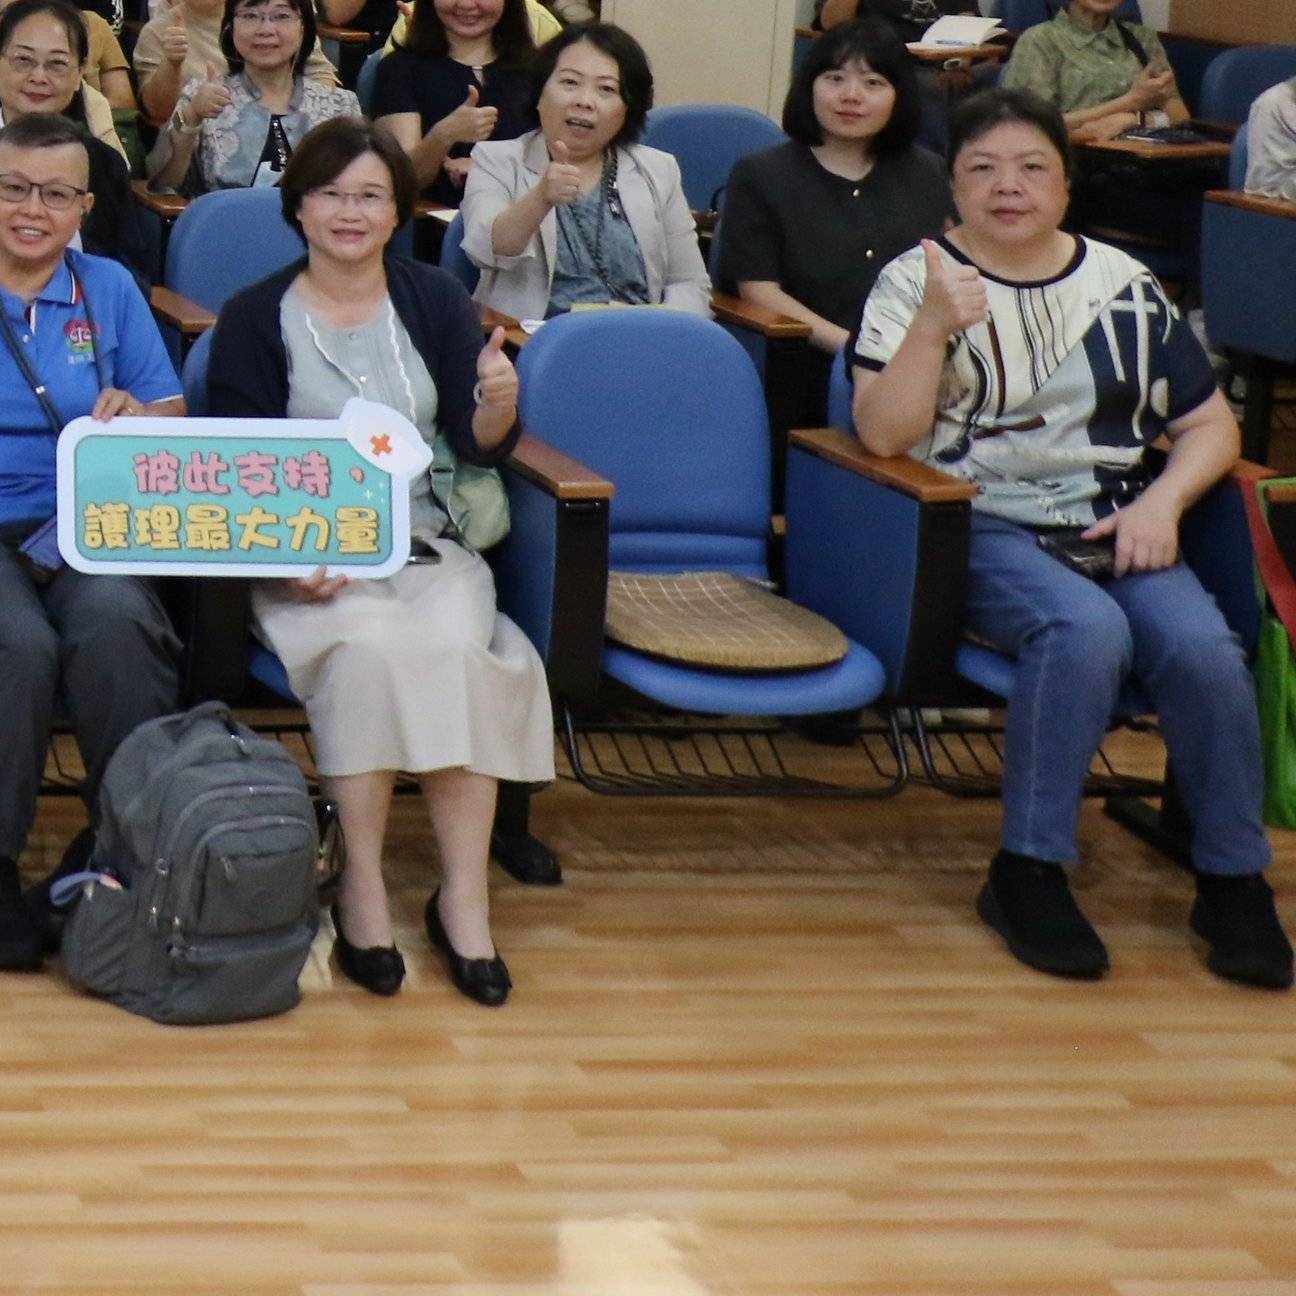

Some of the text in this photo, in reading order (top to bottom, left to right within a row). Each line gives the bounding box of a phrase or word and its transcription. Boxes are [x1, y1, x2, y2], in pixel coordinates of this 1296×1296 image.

[82, 502, 380, 554] 護理最大力量
